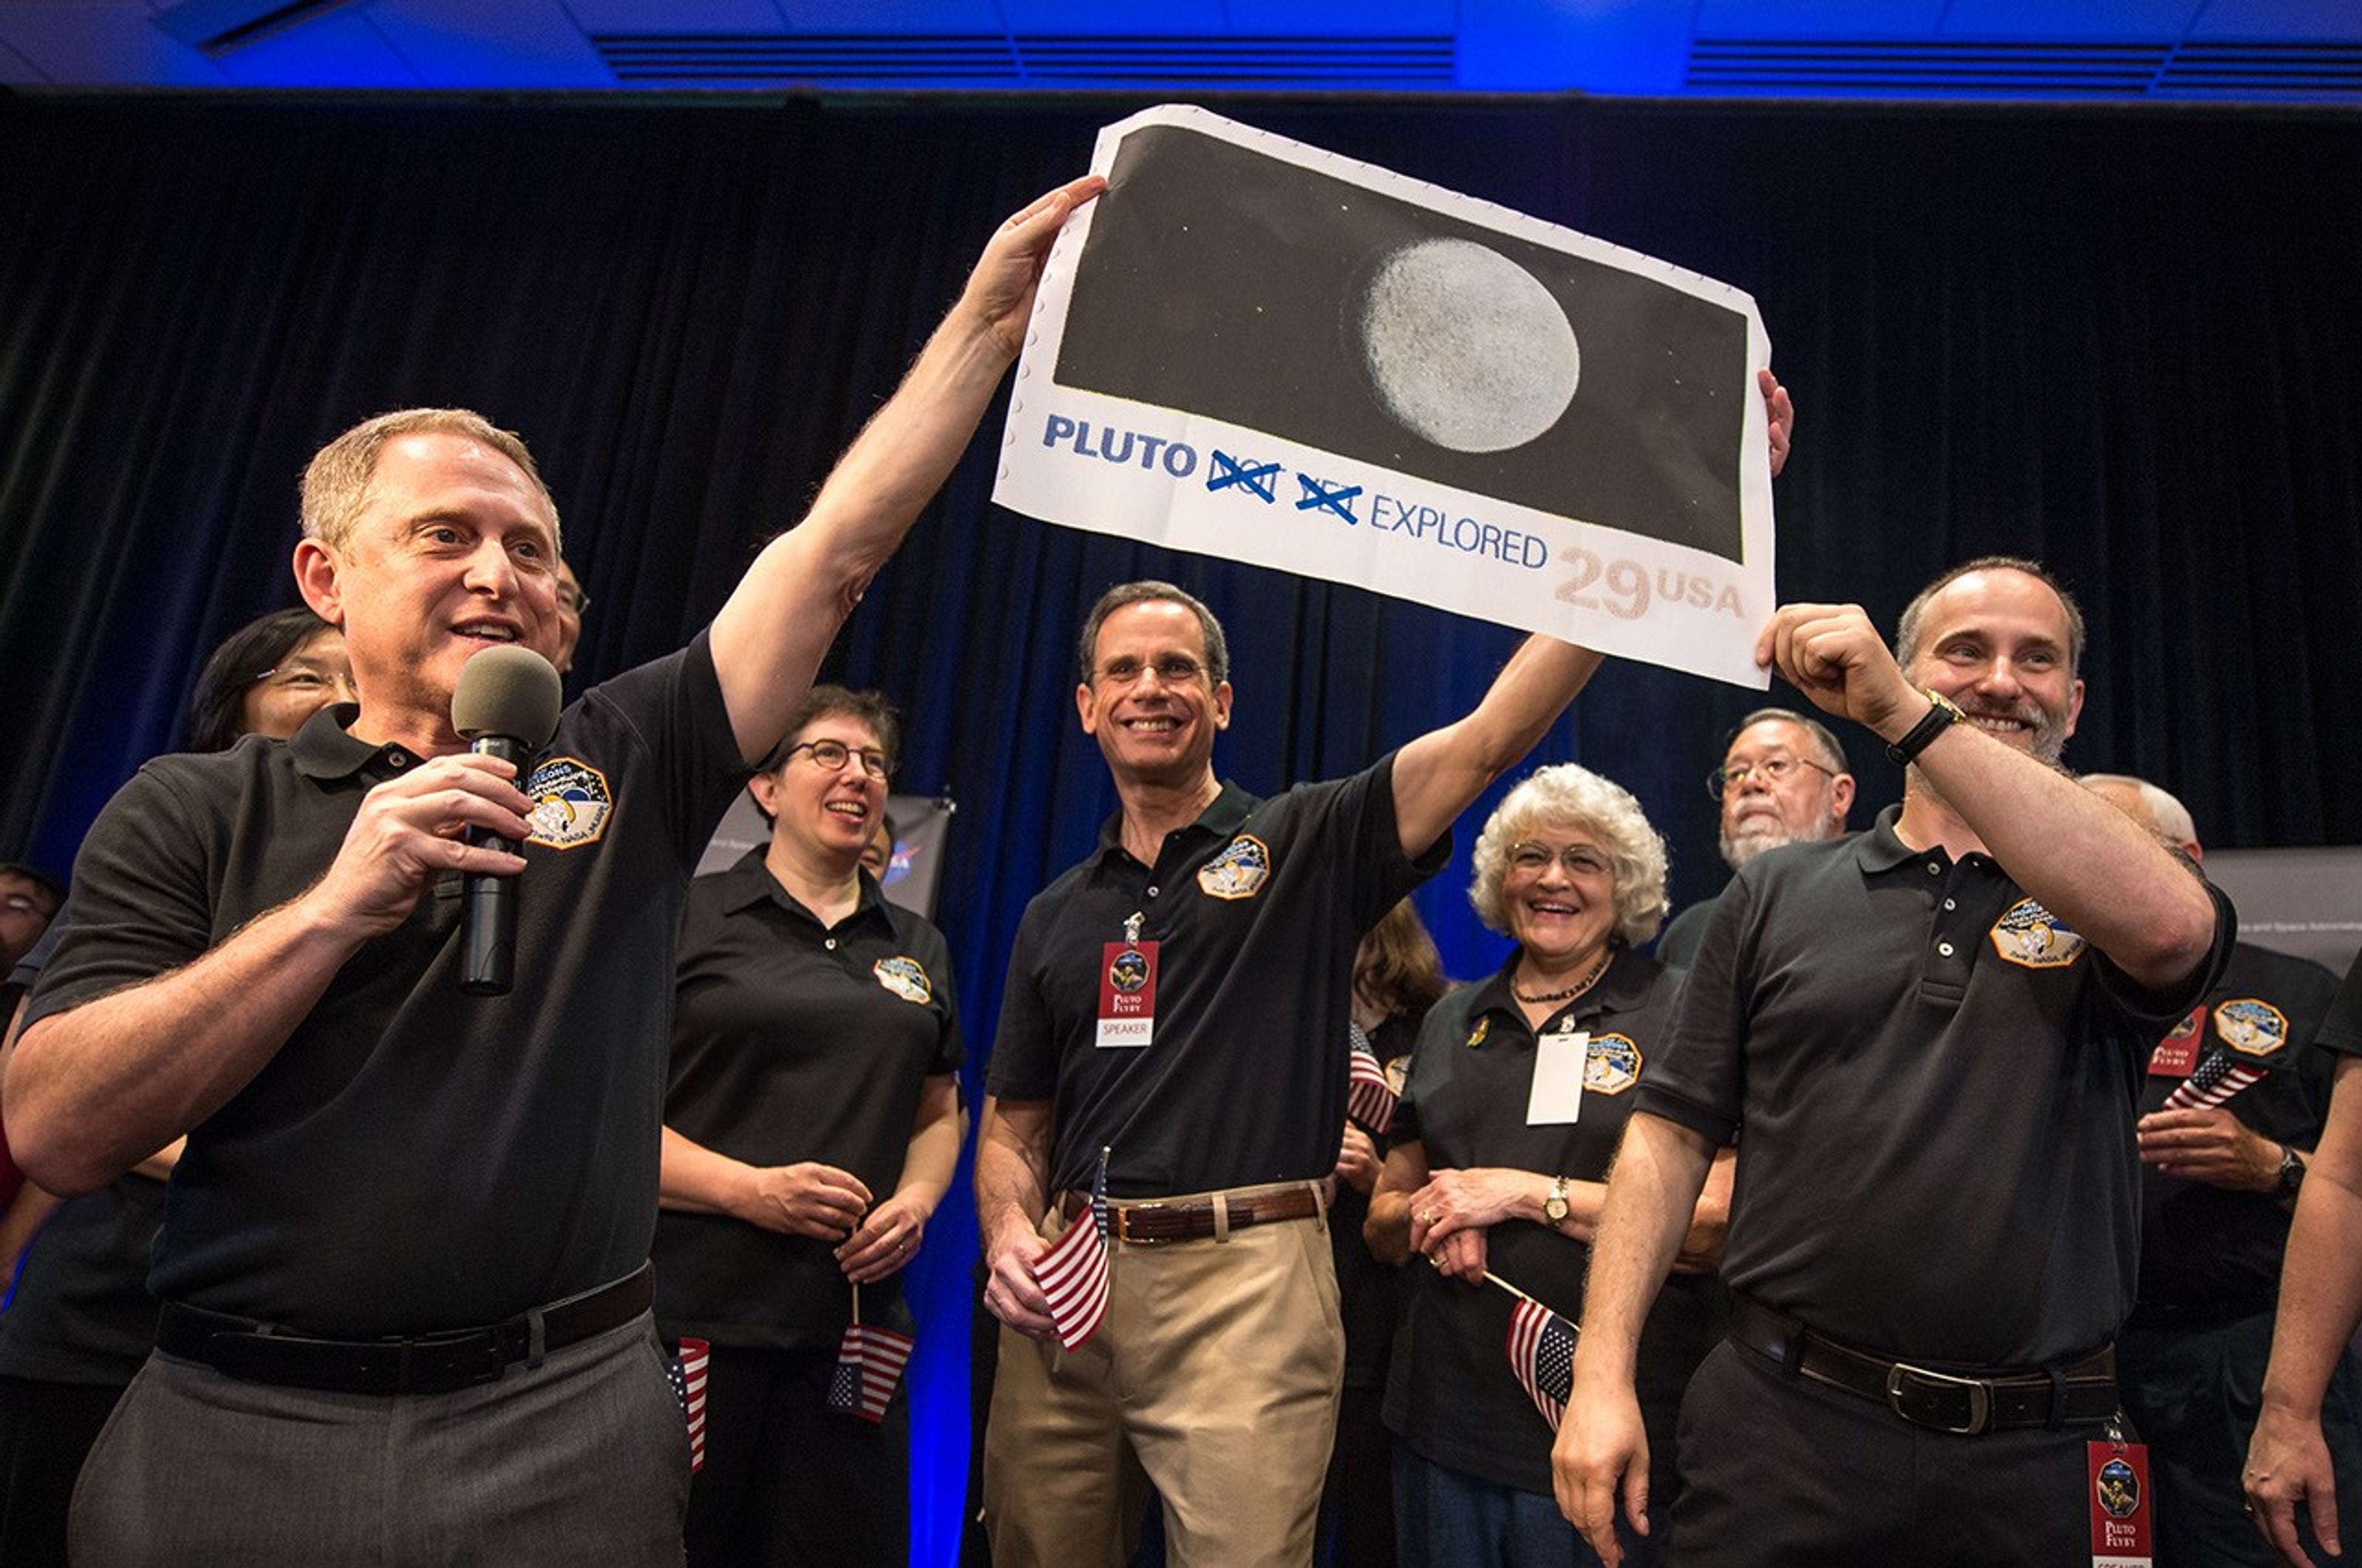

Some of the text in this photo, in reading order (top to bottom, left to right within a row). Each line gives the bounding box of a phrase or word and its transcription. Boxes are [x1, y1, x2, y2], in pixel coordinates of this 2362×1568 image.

[1043, 414, 1197, 477] PLUTO
[1370, 494, 1548, 569] EXPLORED
[1555, 548, 1744, 619] 29 USA
[1103, 1023, 1148, 1036] SPEAKER
